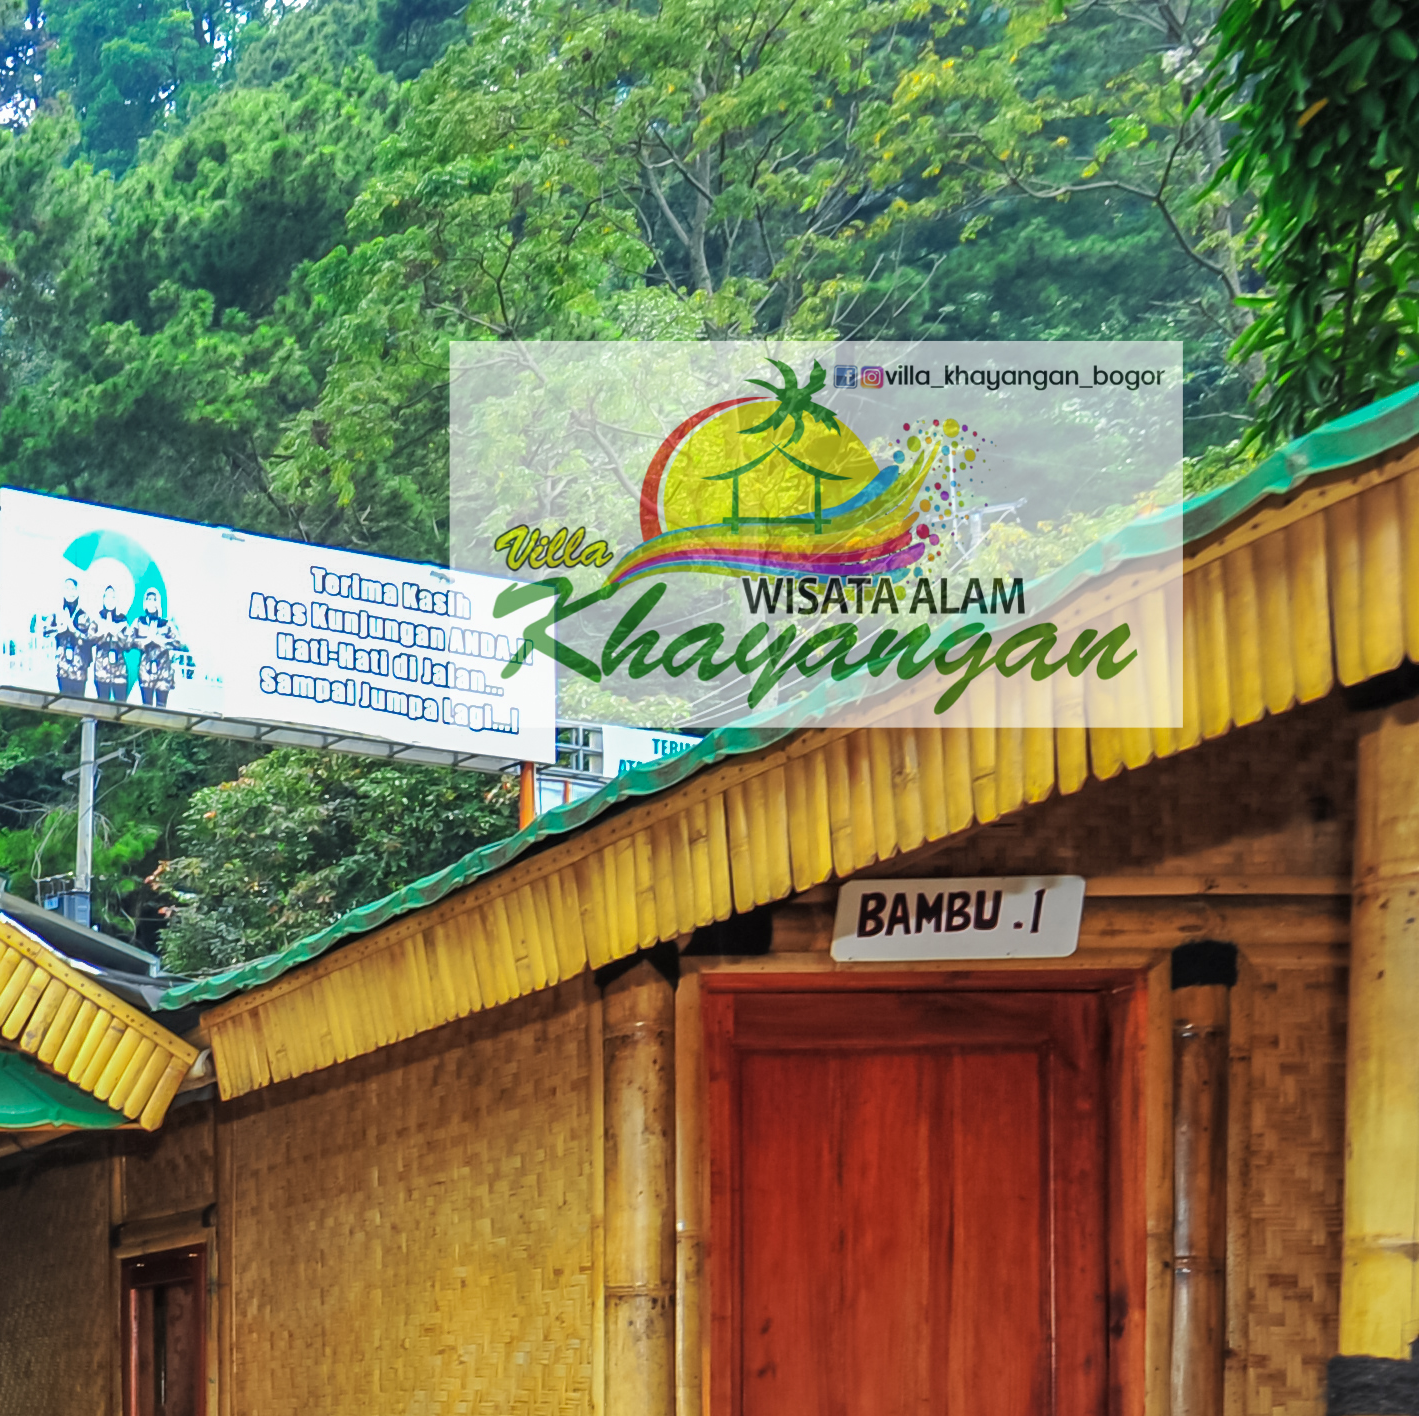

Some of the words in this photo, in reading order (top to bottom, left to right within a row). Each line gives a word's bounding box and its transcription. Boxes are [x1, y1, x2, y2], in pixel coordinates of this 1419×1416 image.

[310, 565, 399, 607] Terima
[401, 581, 472, 621] Kasih
[249, 591, 308, 627] Atas
[310, 601, 446, 652] Kunjungan
[276, 632, 390, 677] Hati-Hati
[392, 652, 418, 683] di
[259, 665, 356, 706] Sampai
[358, 681, 440, 723] Jumpa
[856, 889, 1003, 939] BAMBU
